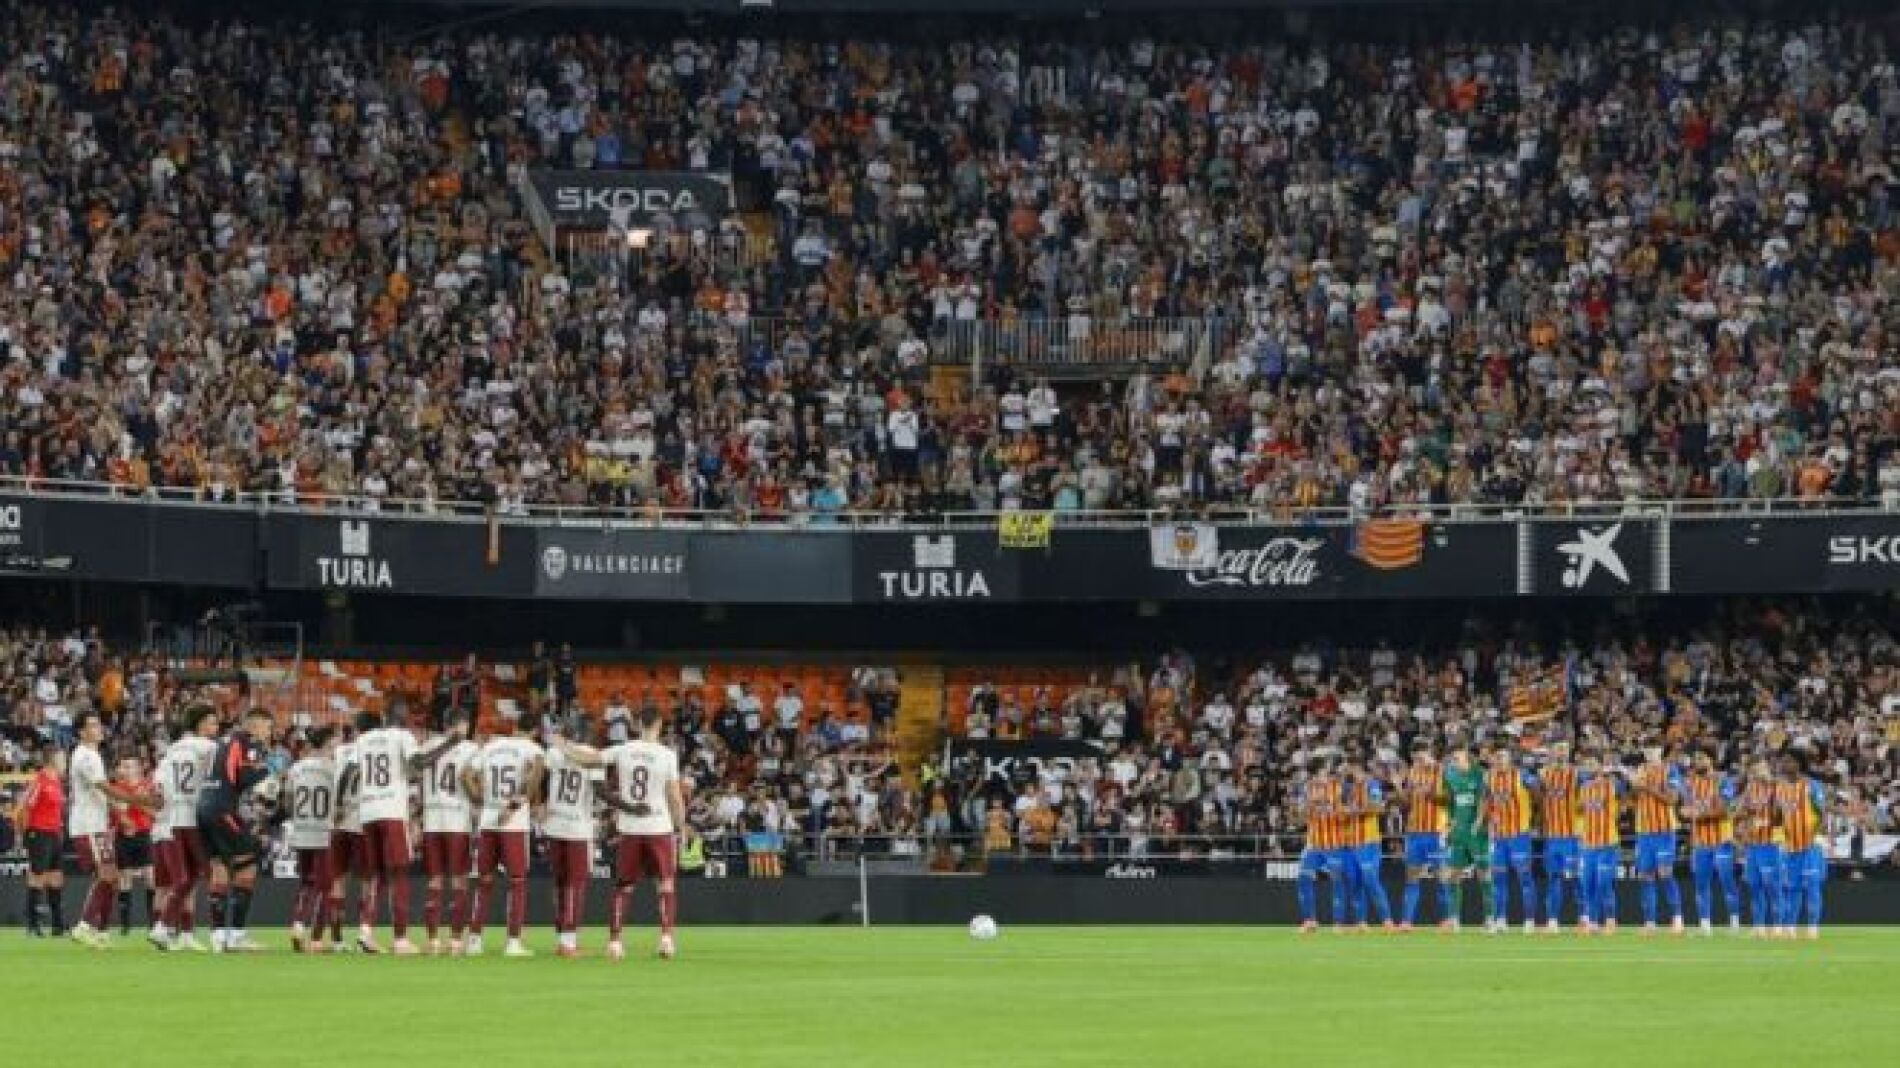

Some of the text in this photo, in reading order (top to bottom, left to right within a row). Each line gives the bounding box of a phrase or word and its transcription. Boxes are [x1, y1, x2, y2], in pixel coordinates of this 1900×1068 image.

[317, 557, 393, 588] TURIA
[880, 571, 990, 597] TURIA
[172, 760, 195, 795] 12
[364, 752, 390, 788] 18
[430, 760, 456, 796] 14
[490, 765, 517, 798] 15
[555, 767, 583, 804] 19
[629, 765, 649, 801] 8
[295, 785, 330, 819] 20
